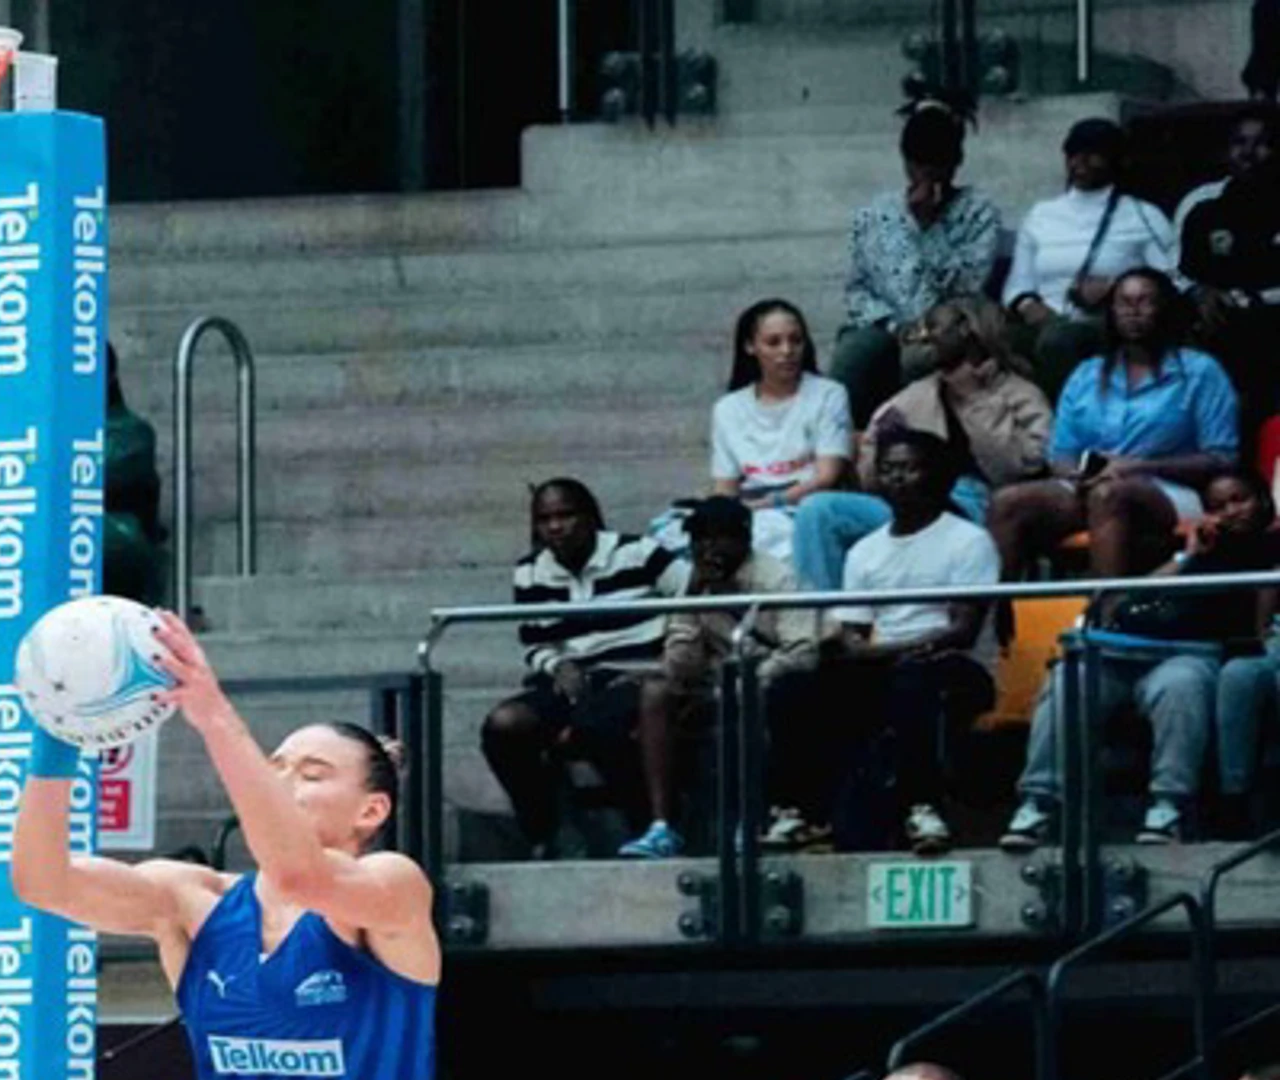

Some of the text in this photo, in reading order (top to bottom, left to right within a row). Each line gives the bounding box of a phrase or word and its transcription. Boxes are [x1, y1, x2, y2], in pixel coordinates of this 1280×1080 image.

[73, 185, 105, 374] Telkom
[886, 866, 956, 921] EXIT
[211, 1039, 340, 1072] Telkom
